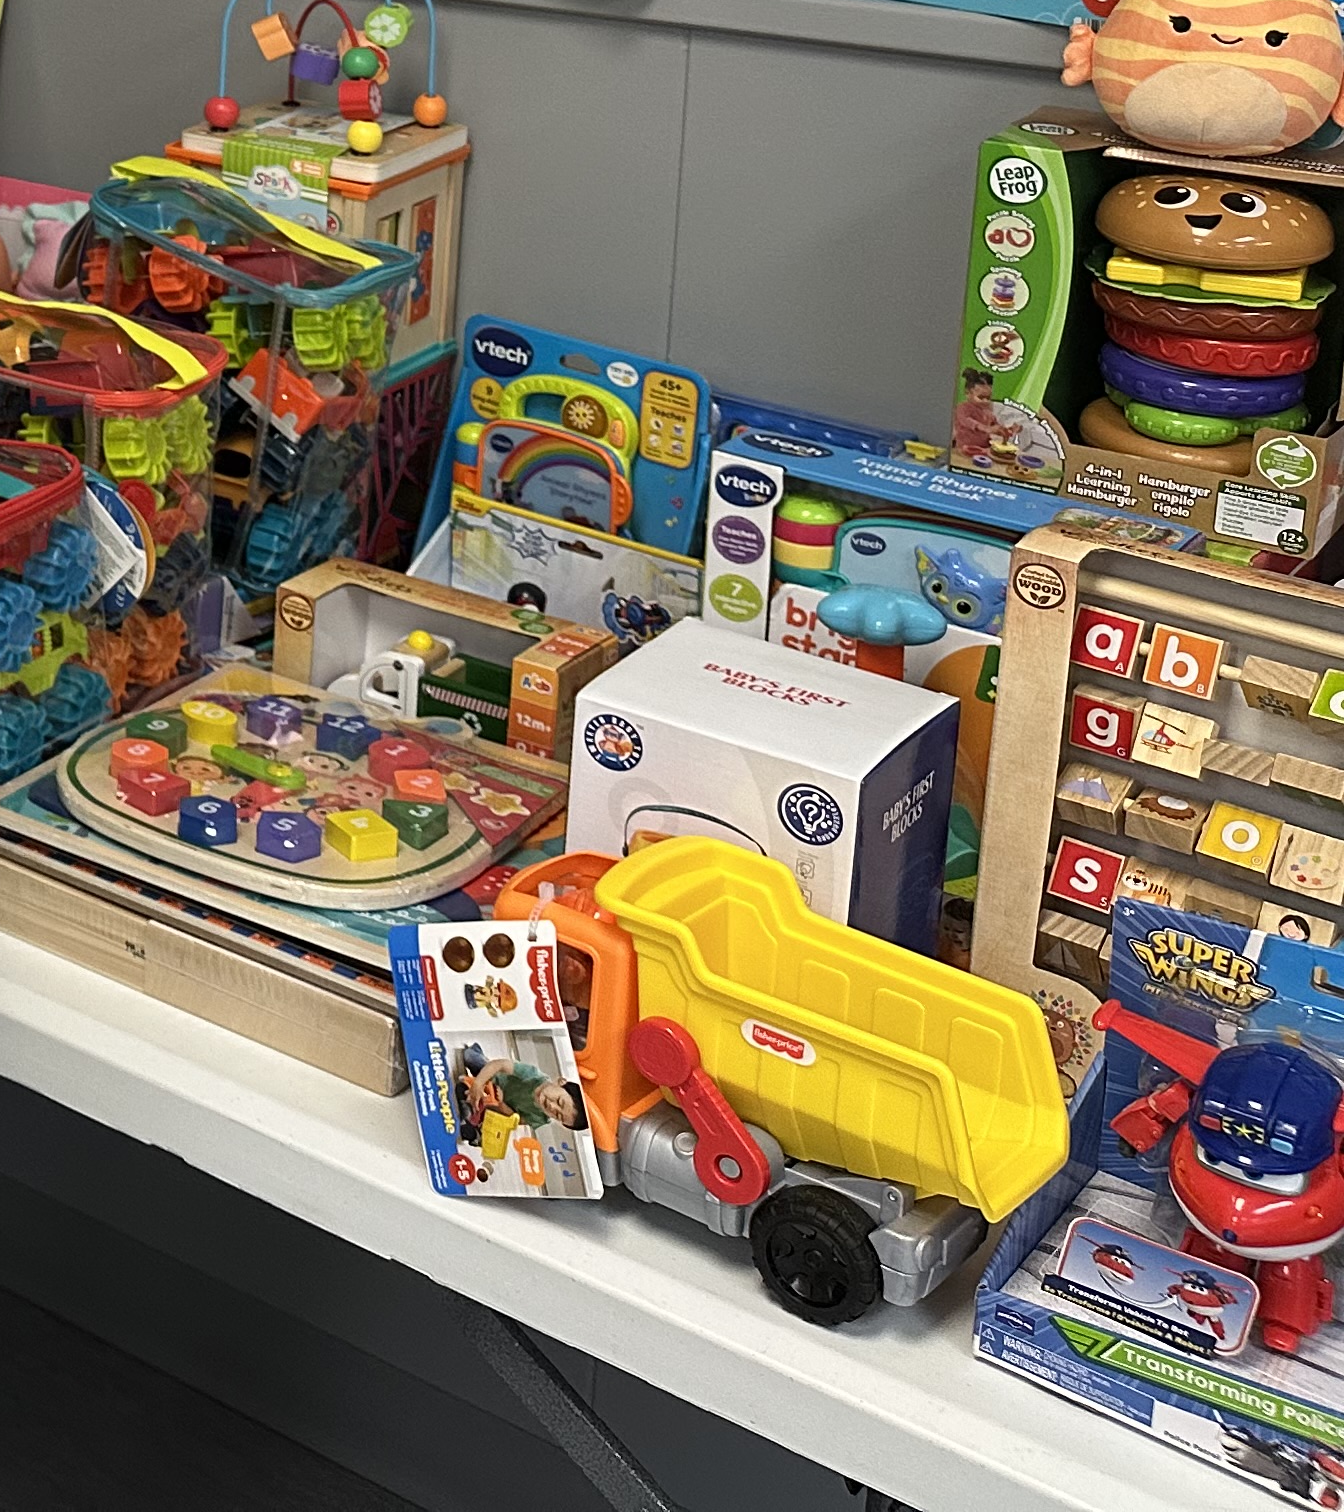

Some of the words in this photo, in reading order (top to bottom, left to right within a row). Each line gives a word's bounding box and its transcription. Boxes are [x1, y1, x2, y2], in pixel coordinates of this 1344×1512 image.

[995, 165, 1035, 182] Leap
[999, 180, 1038, 197] Frog
[474, 337, 529, 366] vtech
[718, 473, 772, 495] vtech
[853, 456, 925, 481] Animal
[932, 474, 1018, 501] Rhymes
[858, 465, 925, 489] Music
[928, 484, 982, 503] Book
[1076, 473, 1132, 497] Learning
[1138, 473, 1211, 498] Hamburger
[1067, 484, 1138, 508] Hamburger
[1151, 490, 1195, 507] empilo
[1153, 502, 1190, 519] rigolo
[850, 536, 884, 551] vtech
[1280, 530, 1305, 543] 12+
[1017, 578, 1062, 597] WOOD
[1160, 635, 1200, 688] b
[703, 662, 781, 690] BABY'S
[785, 685, 853, 709] FIRST
[721, 676, 813, 707] BLOCKS
[882, 787, 912, 832] BABY'S
[912, 769, 936, 801] FIRST
[891, 802, 924, 845] BLOCKS
[1150, 928, 1256, 983] SUPER
[534, 948, 555, 1021] fisher-price
[752, 1026, 805, 1059] fisher-price
[1124, 1347, 1278, 1416] Transforming
